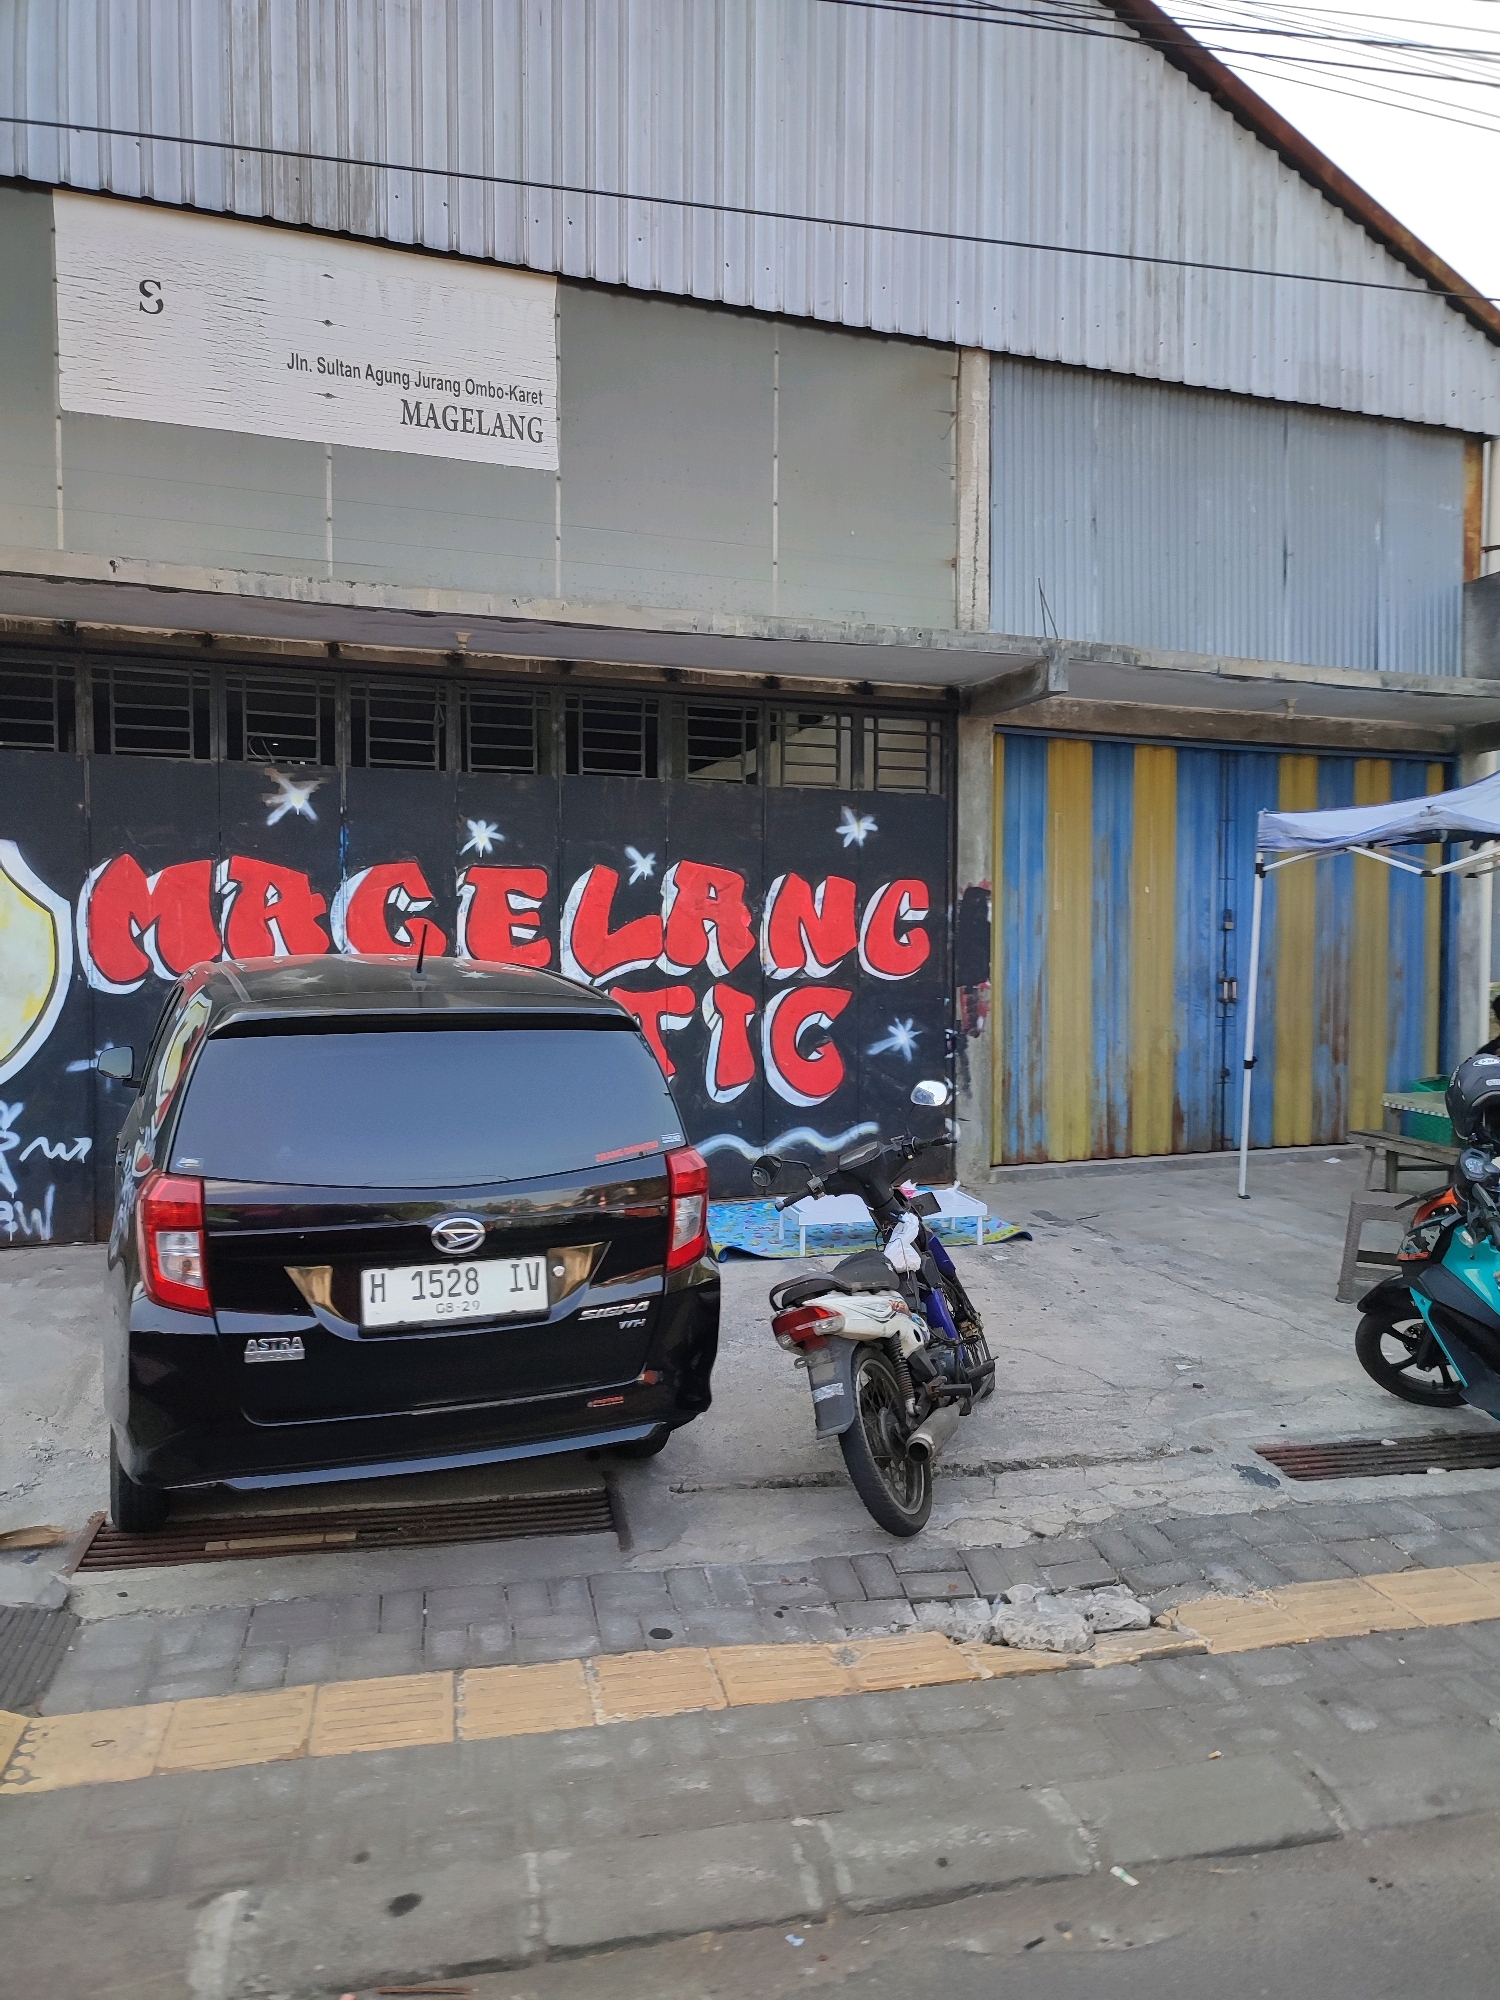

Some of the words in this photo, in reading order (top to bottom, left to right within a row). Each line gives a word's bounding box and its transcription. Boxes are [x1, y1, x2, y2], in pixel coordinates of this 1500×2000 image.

[139, 280, 164, 315] S
[286, 353, 313, 373] Jln.
[316, 356, 361, 380] Sultan
[364, 363, 411, 390] Agung
[414, 371, 461, 398] Jurang
[464, 379, 544, 405] Ombo-Karet
[400, 399, 544, 444] MAGELANG
[77, 853, 931, 994] MAGELANG
[370, 1273, 386, 1303] H
[411, 1267, 479, 1300] 1528
[509, 1262, 540, 1292] IV
[245, 1336, 305, 1352] ASTRA
